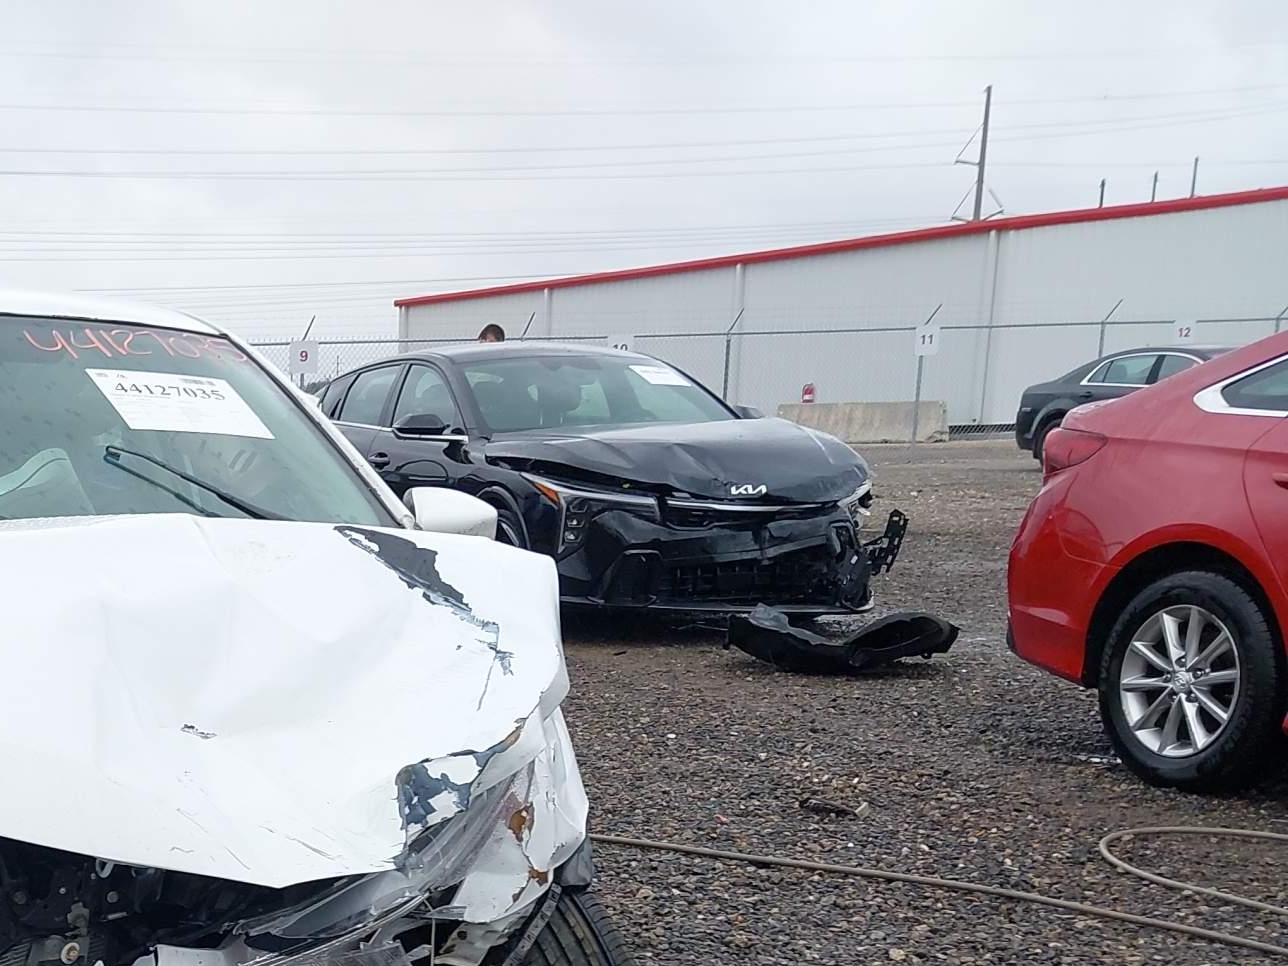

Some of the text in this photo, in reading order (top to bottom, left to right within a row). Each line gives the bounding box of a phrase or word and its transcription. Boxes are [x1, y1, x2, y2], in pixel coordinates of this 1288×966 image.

[1178, 327, 1191, 338] 12
[921, 334, 933, 345] 11
[299, 350, 309, 362] 9
[114, 382, 226, 400] 44127035
